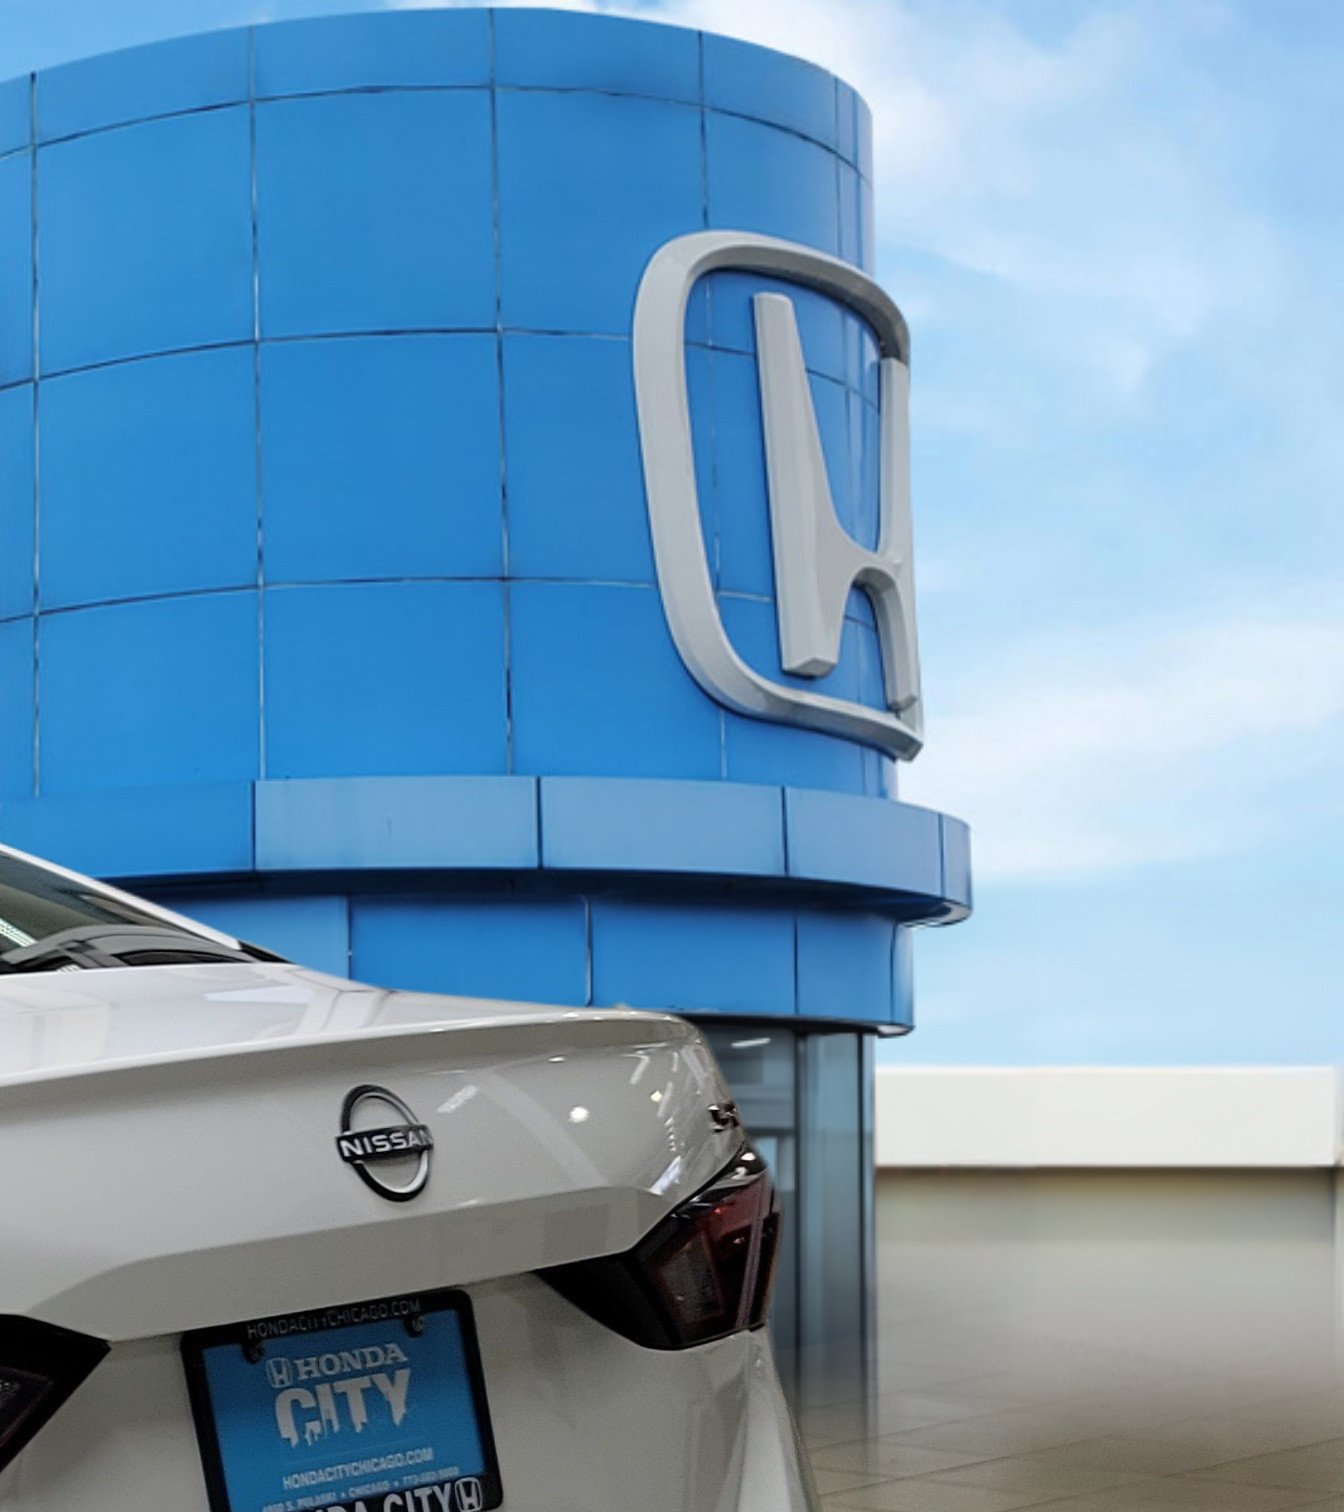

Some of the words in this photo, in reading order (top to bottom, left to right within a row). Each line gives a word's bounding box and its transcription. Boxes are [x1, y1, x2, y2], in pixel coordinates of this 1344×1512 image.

[339, 1129, 430, 1157] NISSAN
[296, 1342, 409, 1381] HONDA
[274, 1367, 412, 1448] CITY
